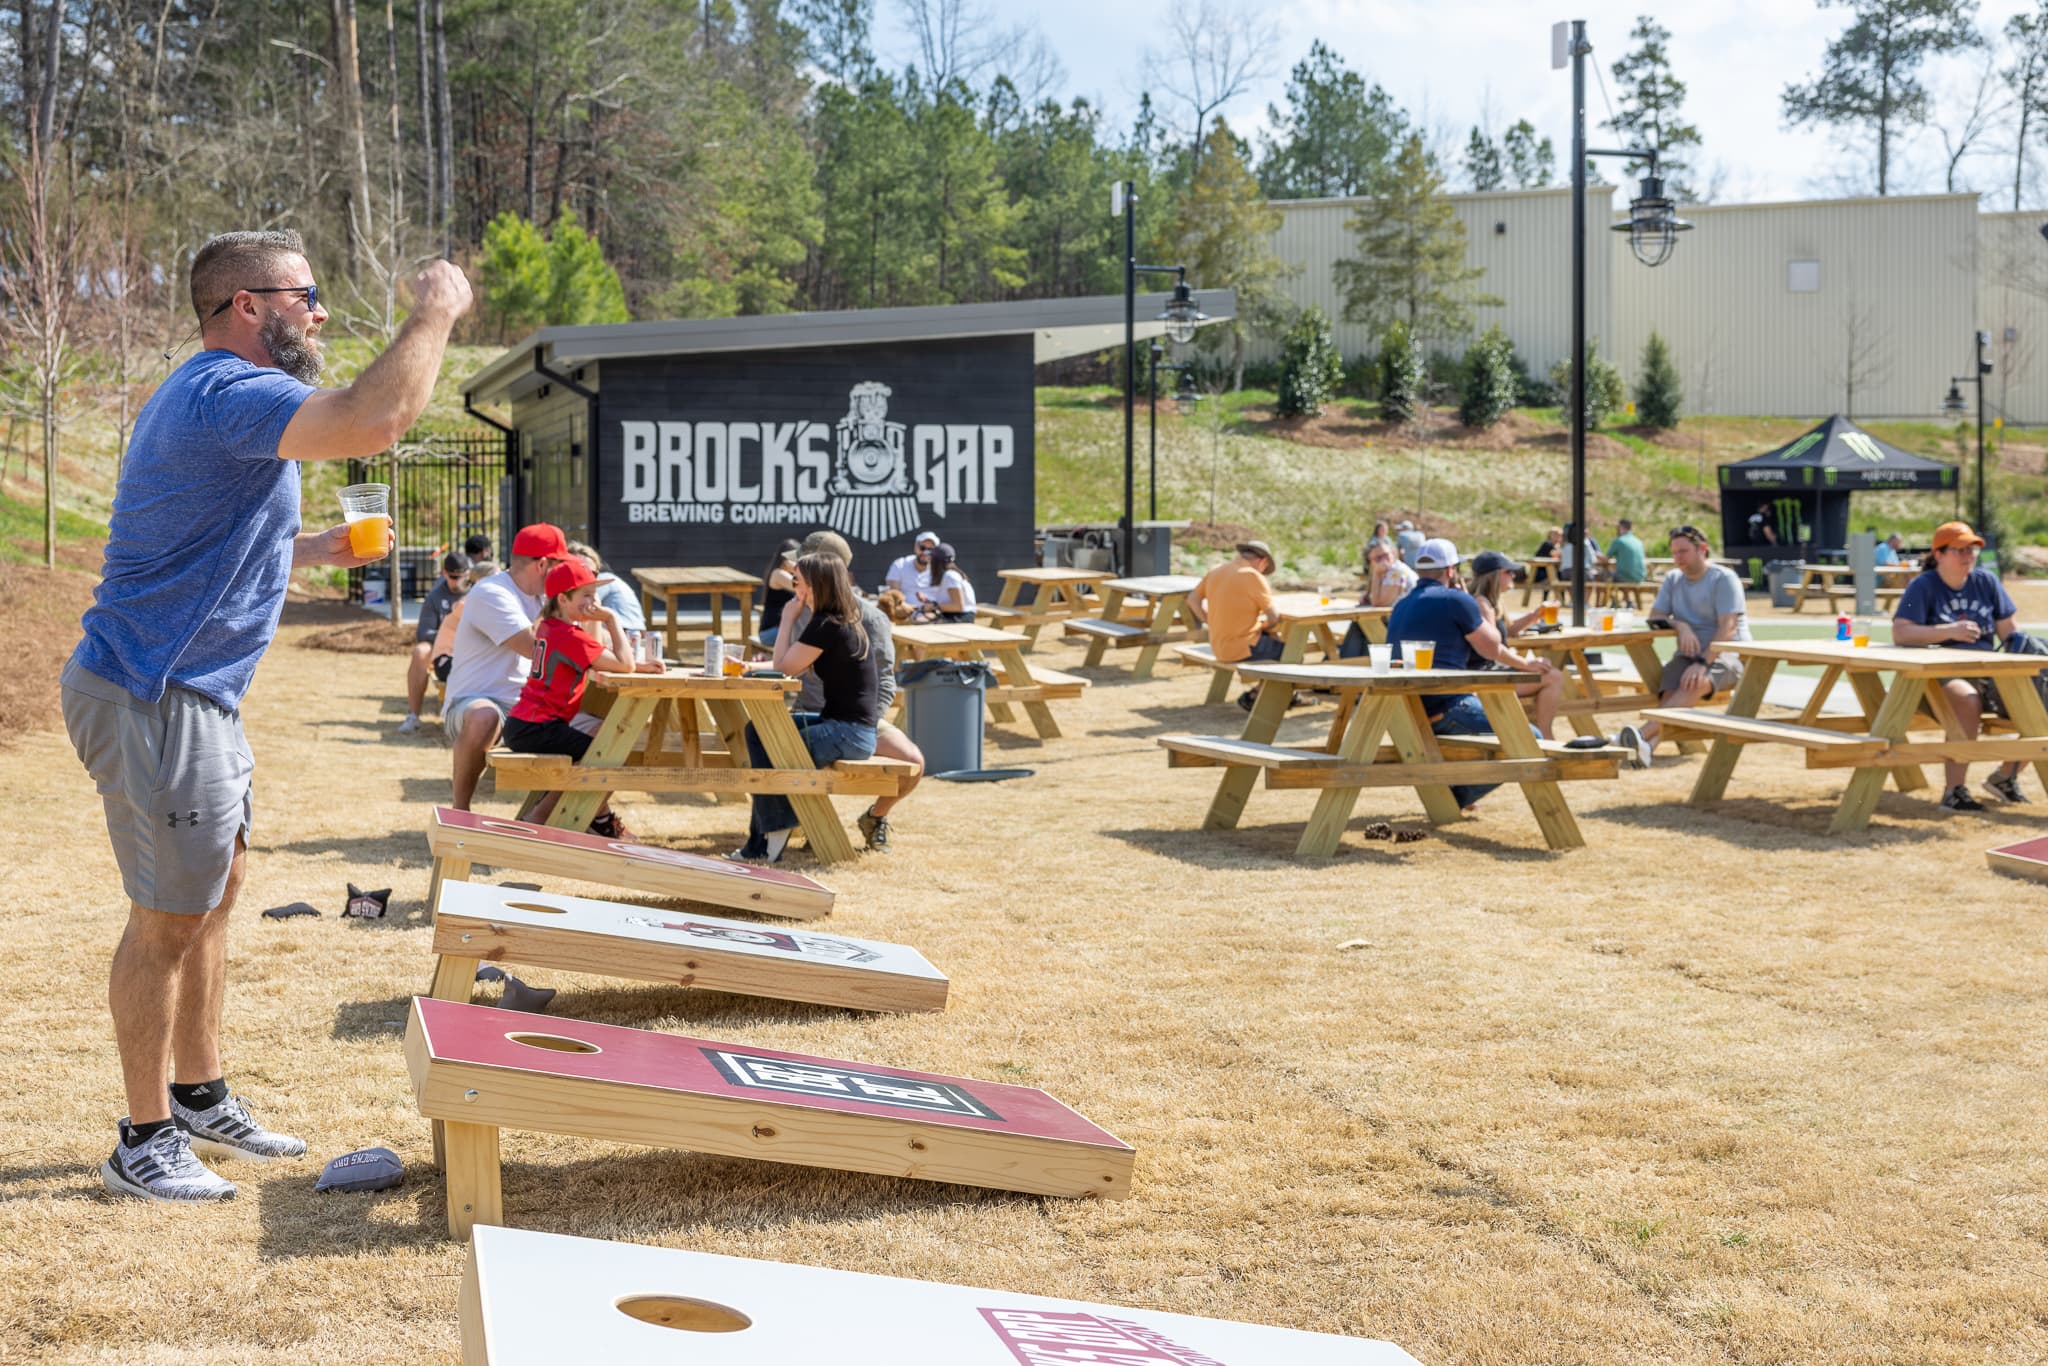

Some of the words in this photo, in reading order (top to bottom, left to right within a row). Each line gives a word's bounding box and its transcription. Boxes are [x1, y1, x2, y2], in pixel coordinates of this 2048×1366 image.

[620, 420, 831, 504] BROCK'S
[912, 424, 1014, 519] GAP
[627, 503, 725, 523] BREWING
[729, 504, 830, 524] COMPANY
[1096, 1315, 1227, 1366] OMPANY
